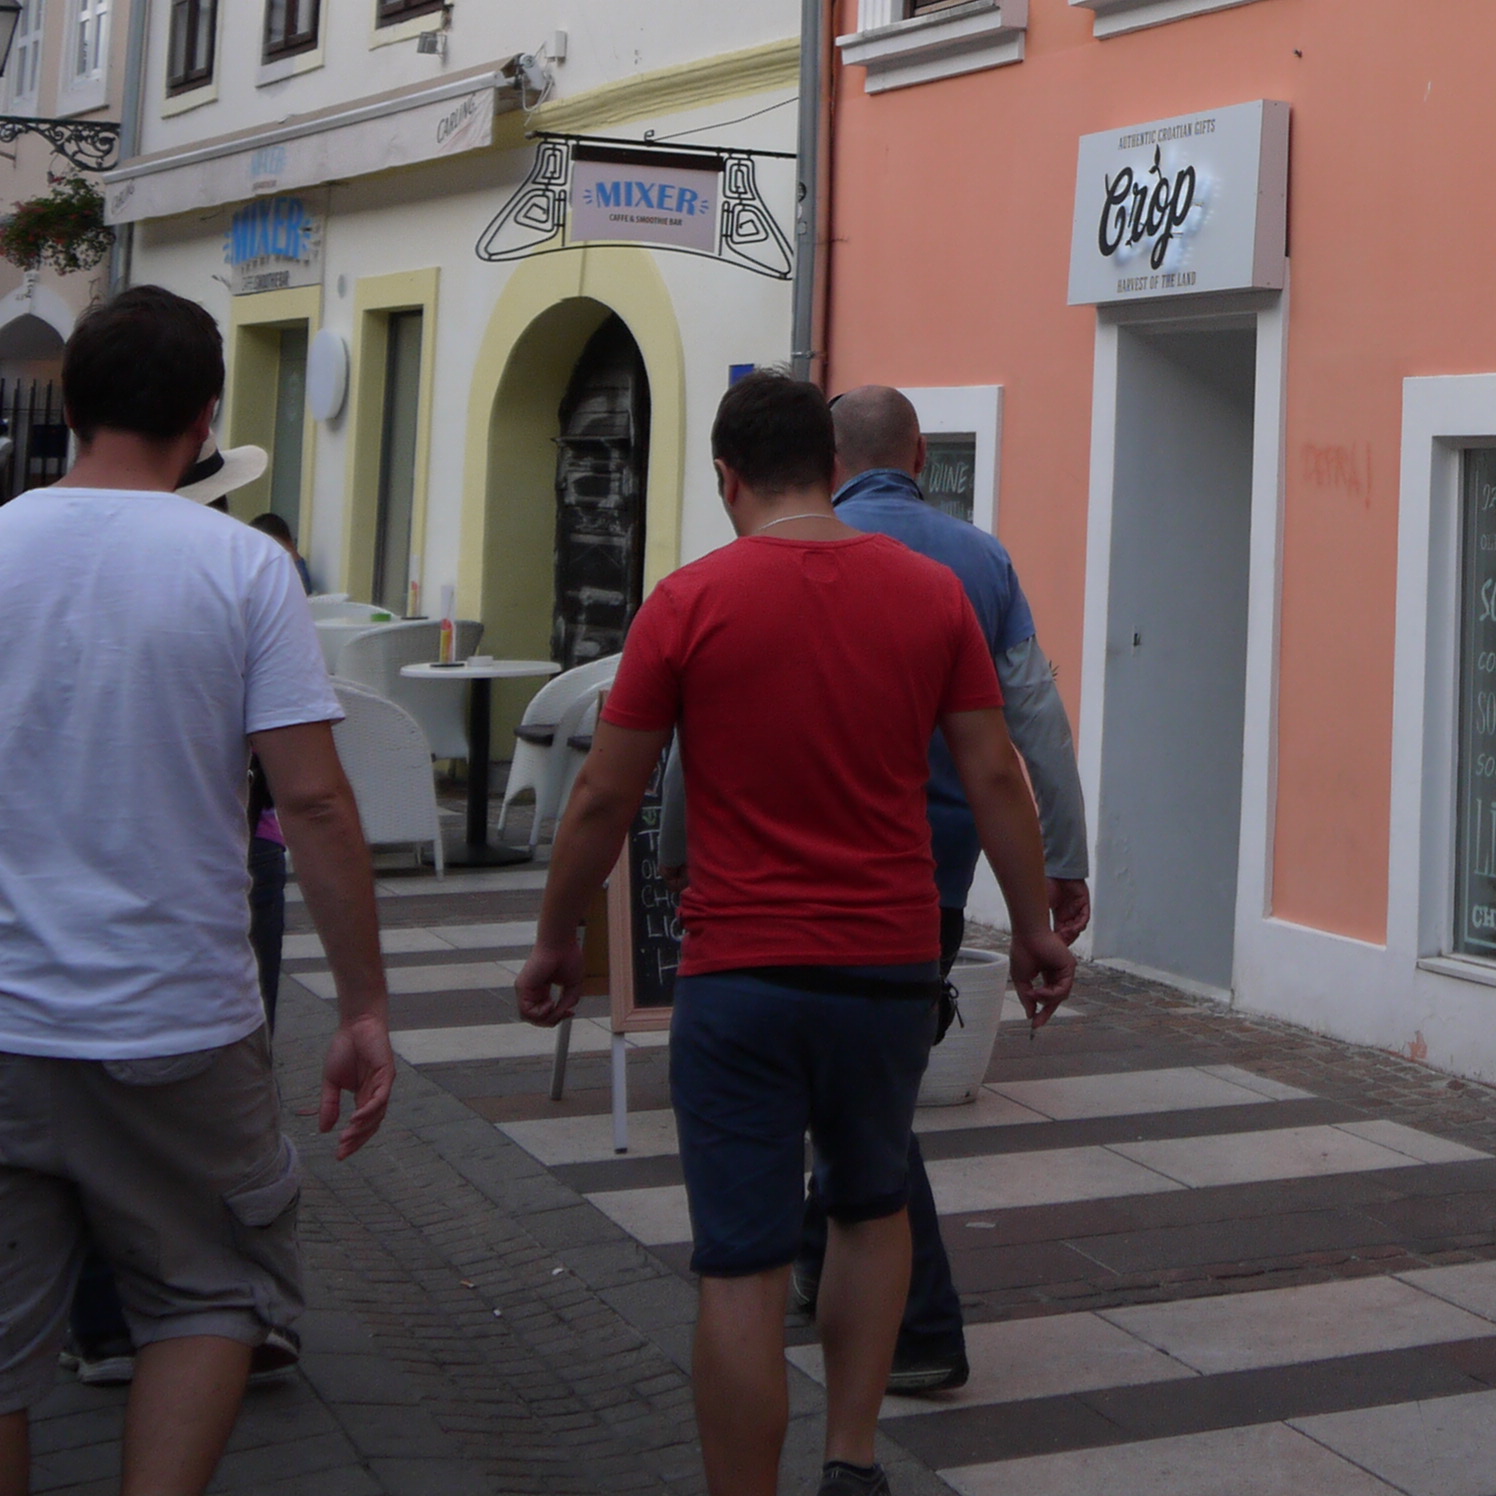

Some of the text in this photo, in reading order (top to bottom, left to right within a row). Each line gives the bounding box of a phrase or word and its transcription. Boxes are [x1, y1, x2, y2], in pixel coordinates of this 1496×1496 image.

[1119, 118, 1216, 150] AUTHENTIC CROATIAN GIFTS
[595, 181, 699, 217] MIXER
[231, 195, 304, 268] MIXER
[609, 213, 629, 223] CAFFE
[635, 215, 669, 225] SMOOTHIE
[669, 217, 683, 226] BAR
[1098, 162, 1197, 271] Crop
[1117, 271, 1197, 294] HARVEST OF THE LAND
[929, 461, 970, 495] WINE
